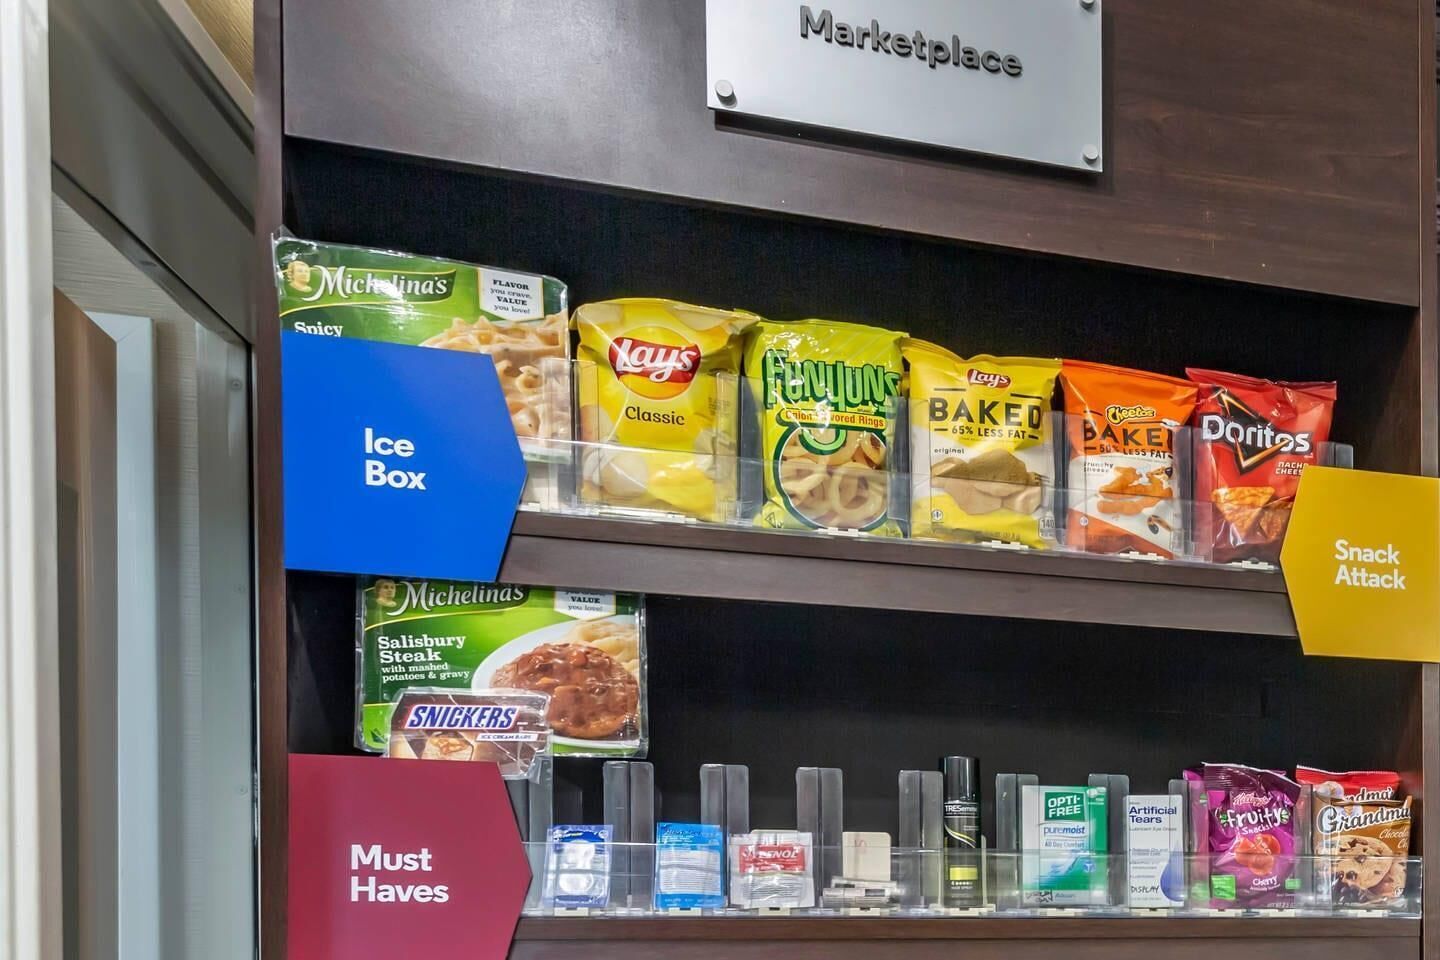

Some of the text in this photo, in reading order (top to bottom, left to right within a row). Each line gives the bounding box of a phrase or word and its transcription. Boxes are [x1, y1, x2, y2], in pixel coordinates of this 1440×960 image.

[799, 5, 1023, 77] Marketplace
[493, 279, 530, 291] FLAVOR
[496, 295, 528, 306] VALUE
[625, 405, 686, 426] Classic
[815, 413, 856, 424] vored
[858, 415, 884, 428] Rings
[928, 397, 1042, 430] BAKED
[951, 425, 1027, 440] 65% LESS FAT
[1202, 415, 1311, 453] Doritos
[365, 427, 415, 458] Ice
[933, 447, 965, 455] original
[1123, 448, 1147, 456] LESS
[1150, 449, 1167, 459] FAT
[365, 459, 427, 491] Box
[1334, 539, 1400, 566] Snack
[1334, 566, 1406, 591] Attack
[570, 596, 601, 604] VALUE
[378, 634, 467, 651] Salisbury
[380, 648, 442, 664] Steak
[381, 662, 449, 673] with mashed
[382, 671, 470, 683] potatoes & gravy
[409, 704, 519, 729] SNICKERS
[1047, 794, 1080, 808] OPTI-
[1049, 805, 1081, 818] FREE
[1128, 806, 1177, 815] Artificial
[1129, 815, 1162, 824] Tears
[1044, 826, 1085, 836] puremoist
[351, 844, 432, 872] Must
[350, 876, 449, 903] Haves
